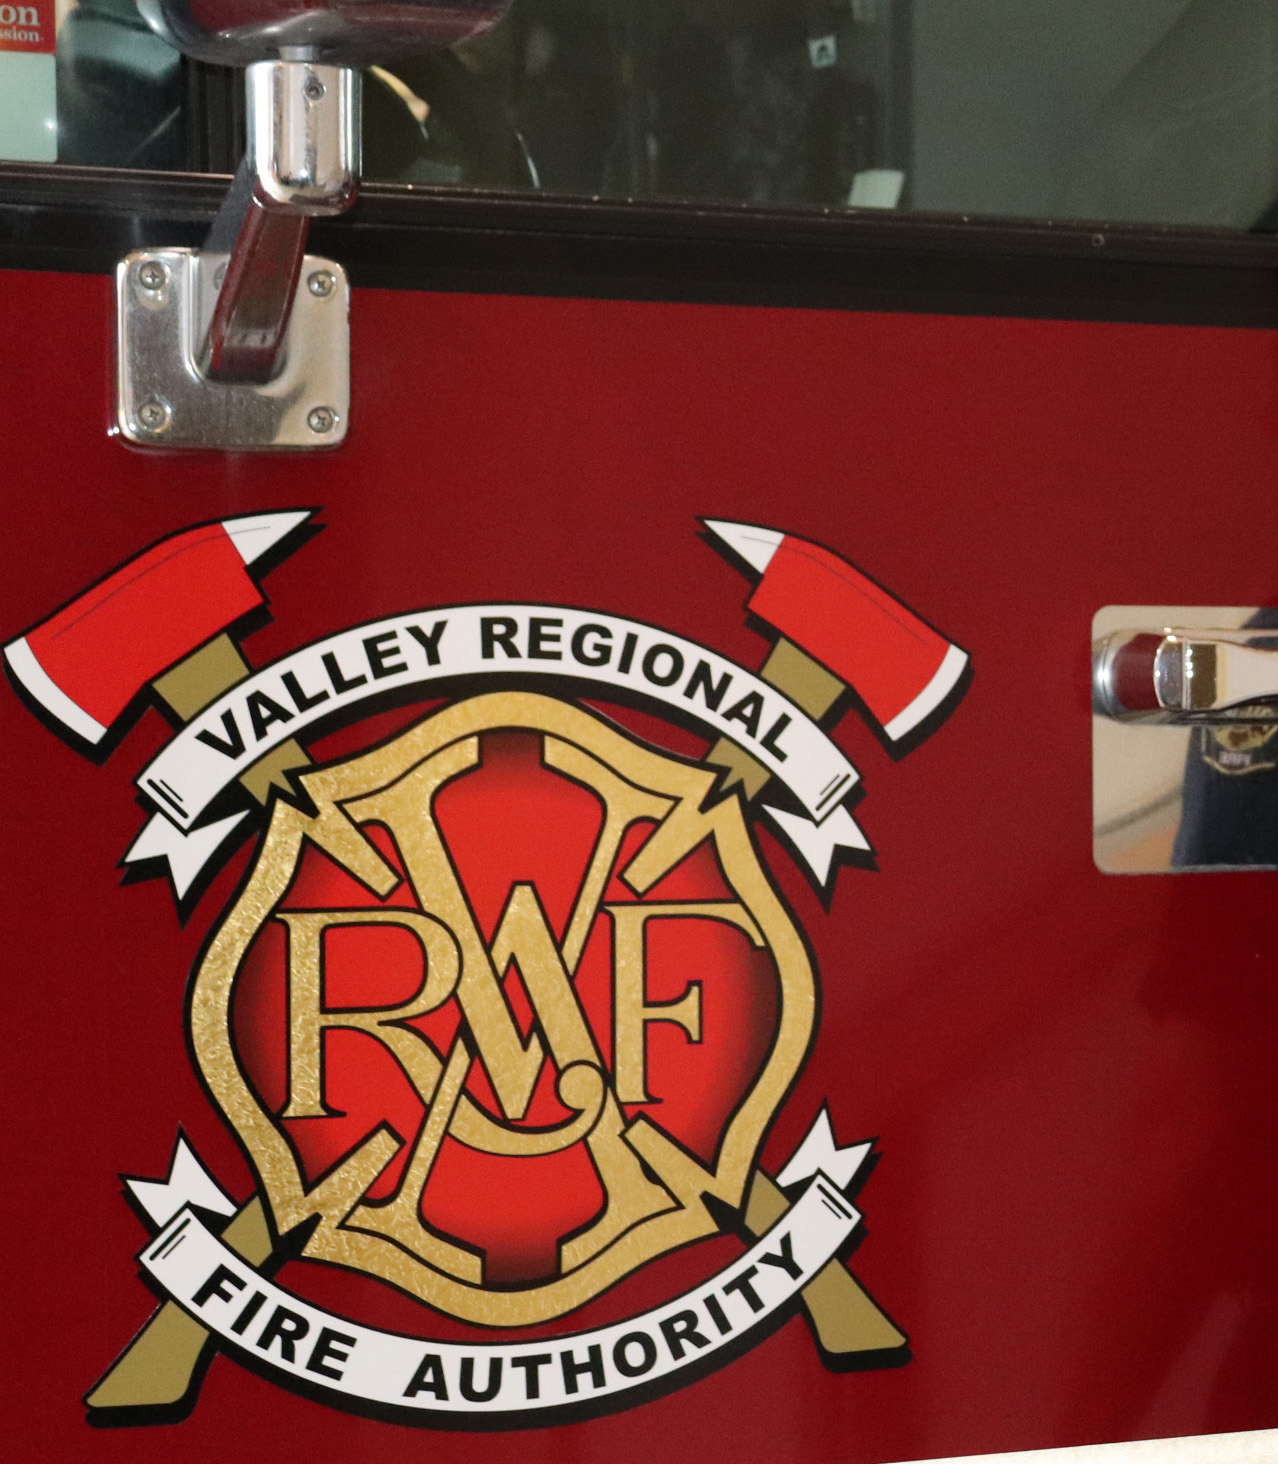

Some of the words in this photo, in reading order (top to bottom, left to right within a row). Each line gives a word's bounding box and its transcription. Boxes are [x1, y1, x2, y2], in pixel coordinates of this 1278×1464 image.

[194, 619, 449, 760] VALLEY
[480, 616, 793, 763] REGIONAL
[190, 1264, 358, 1381] FIRE
[402, 1234, 805, 1403] AUTHORITY
